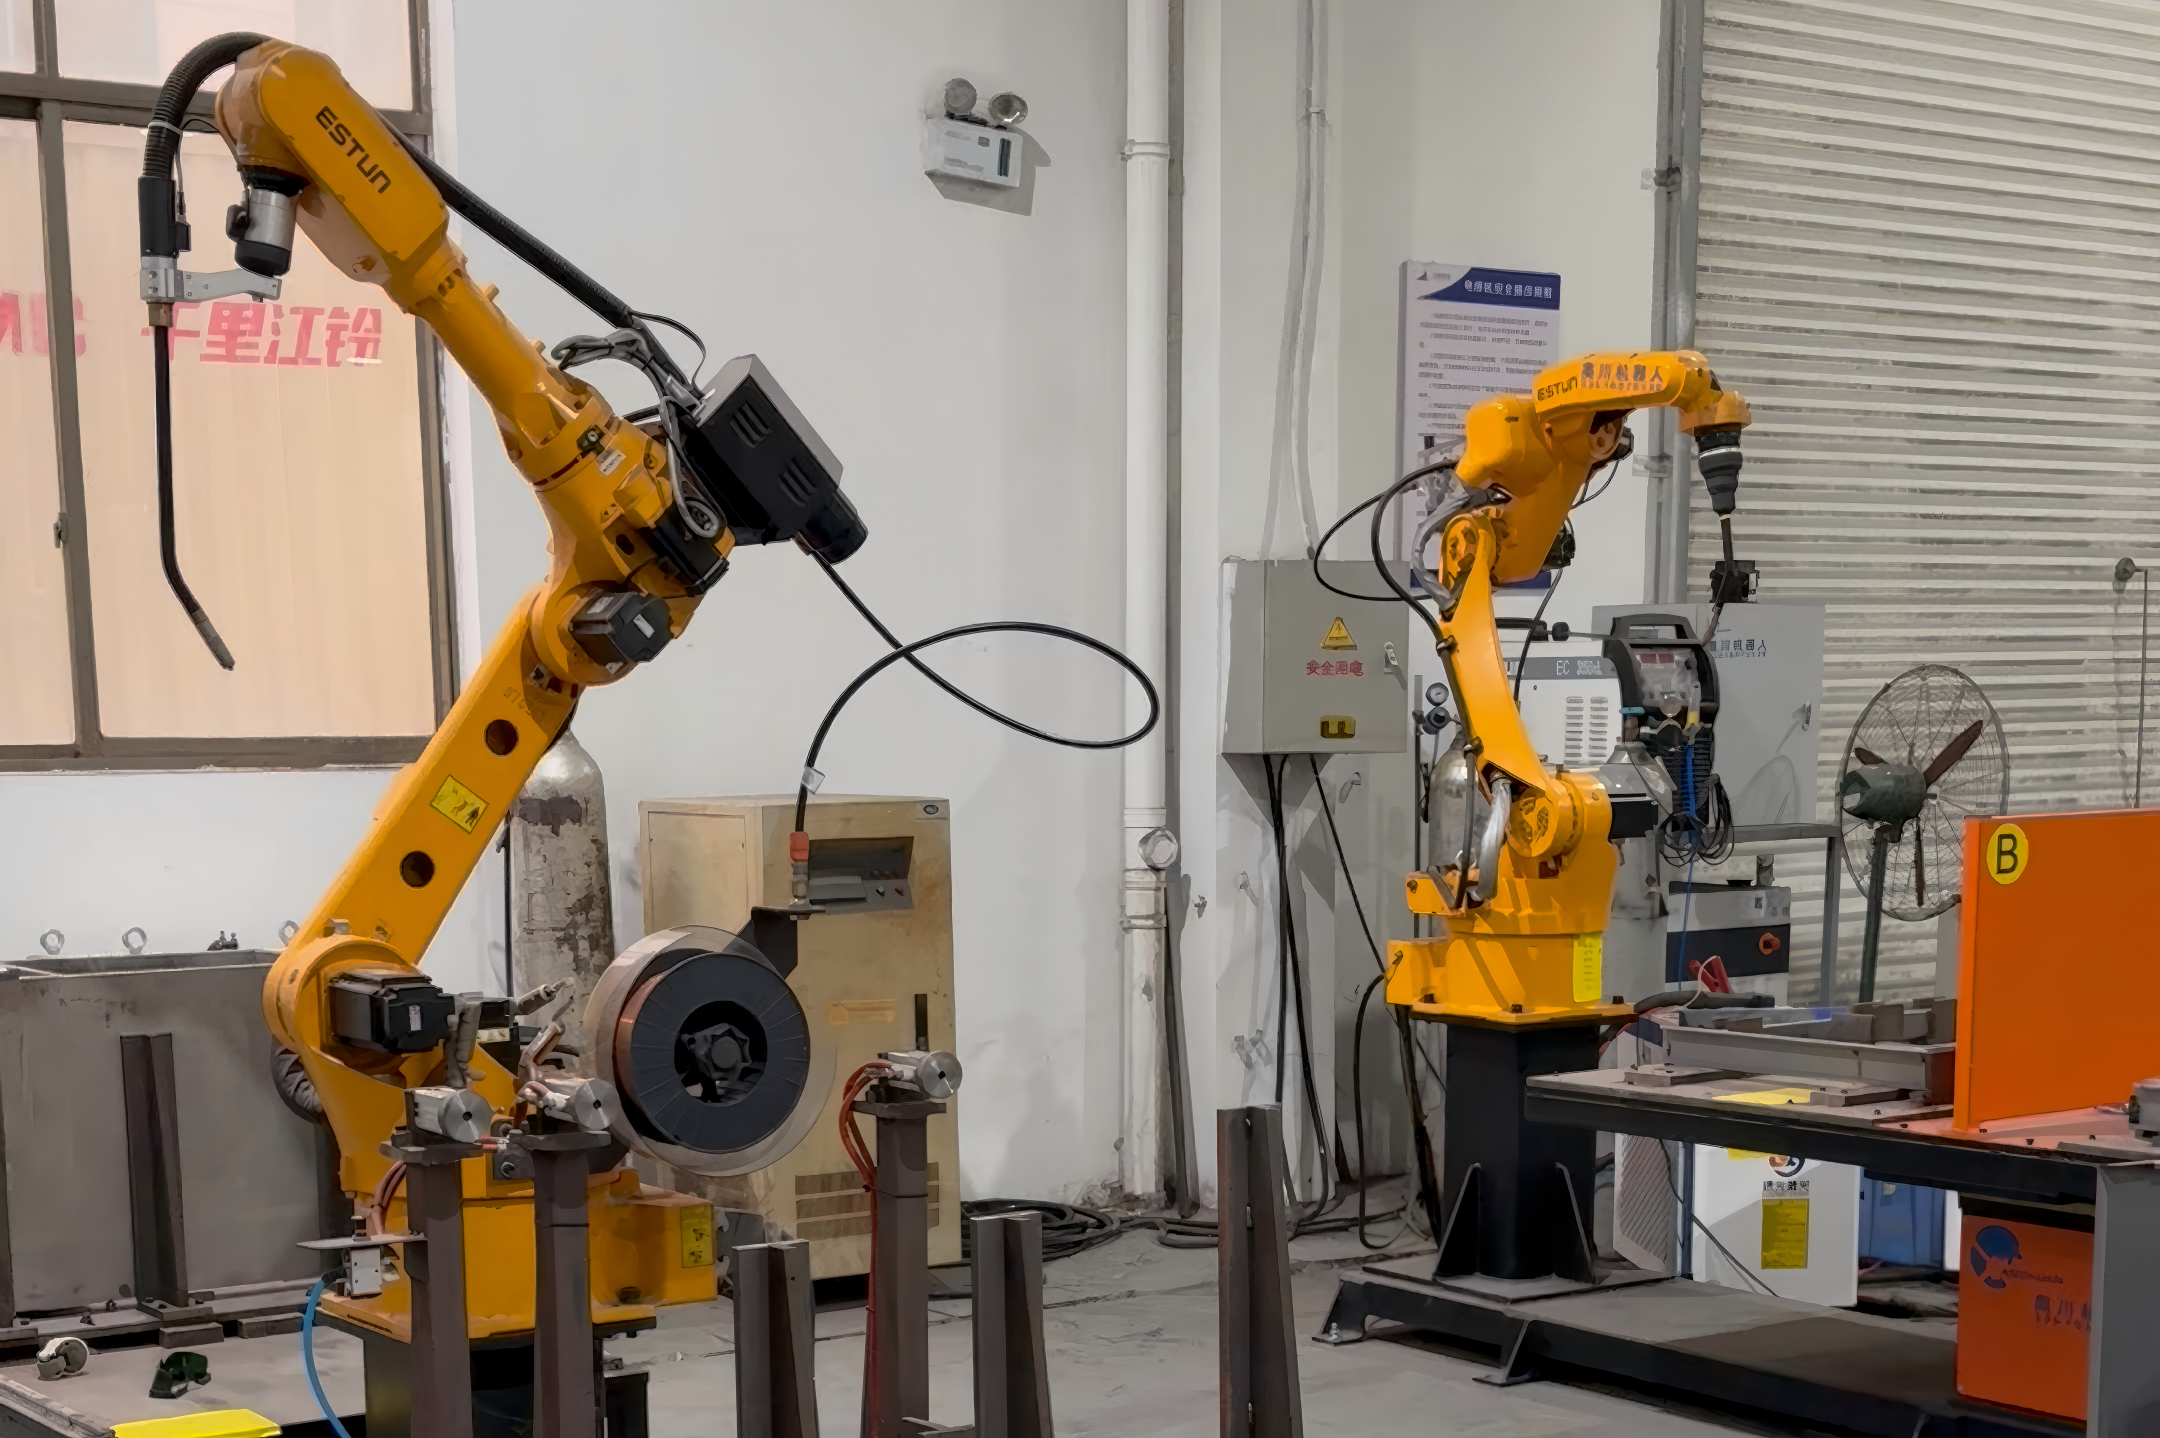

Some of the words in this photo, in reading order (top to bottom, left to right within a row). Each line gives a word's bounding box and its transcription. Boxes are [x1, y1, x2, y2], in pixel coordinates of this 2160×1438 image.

[315, 105, 392, 194] ESTUN
[1537, 375, 1578, 401] ESTUN
[1306, 659, 1364, 677] 安全用电
[1996, 833, 2019, 875] B
